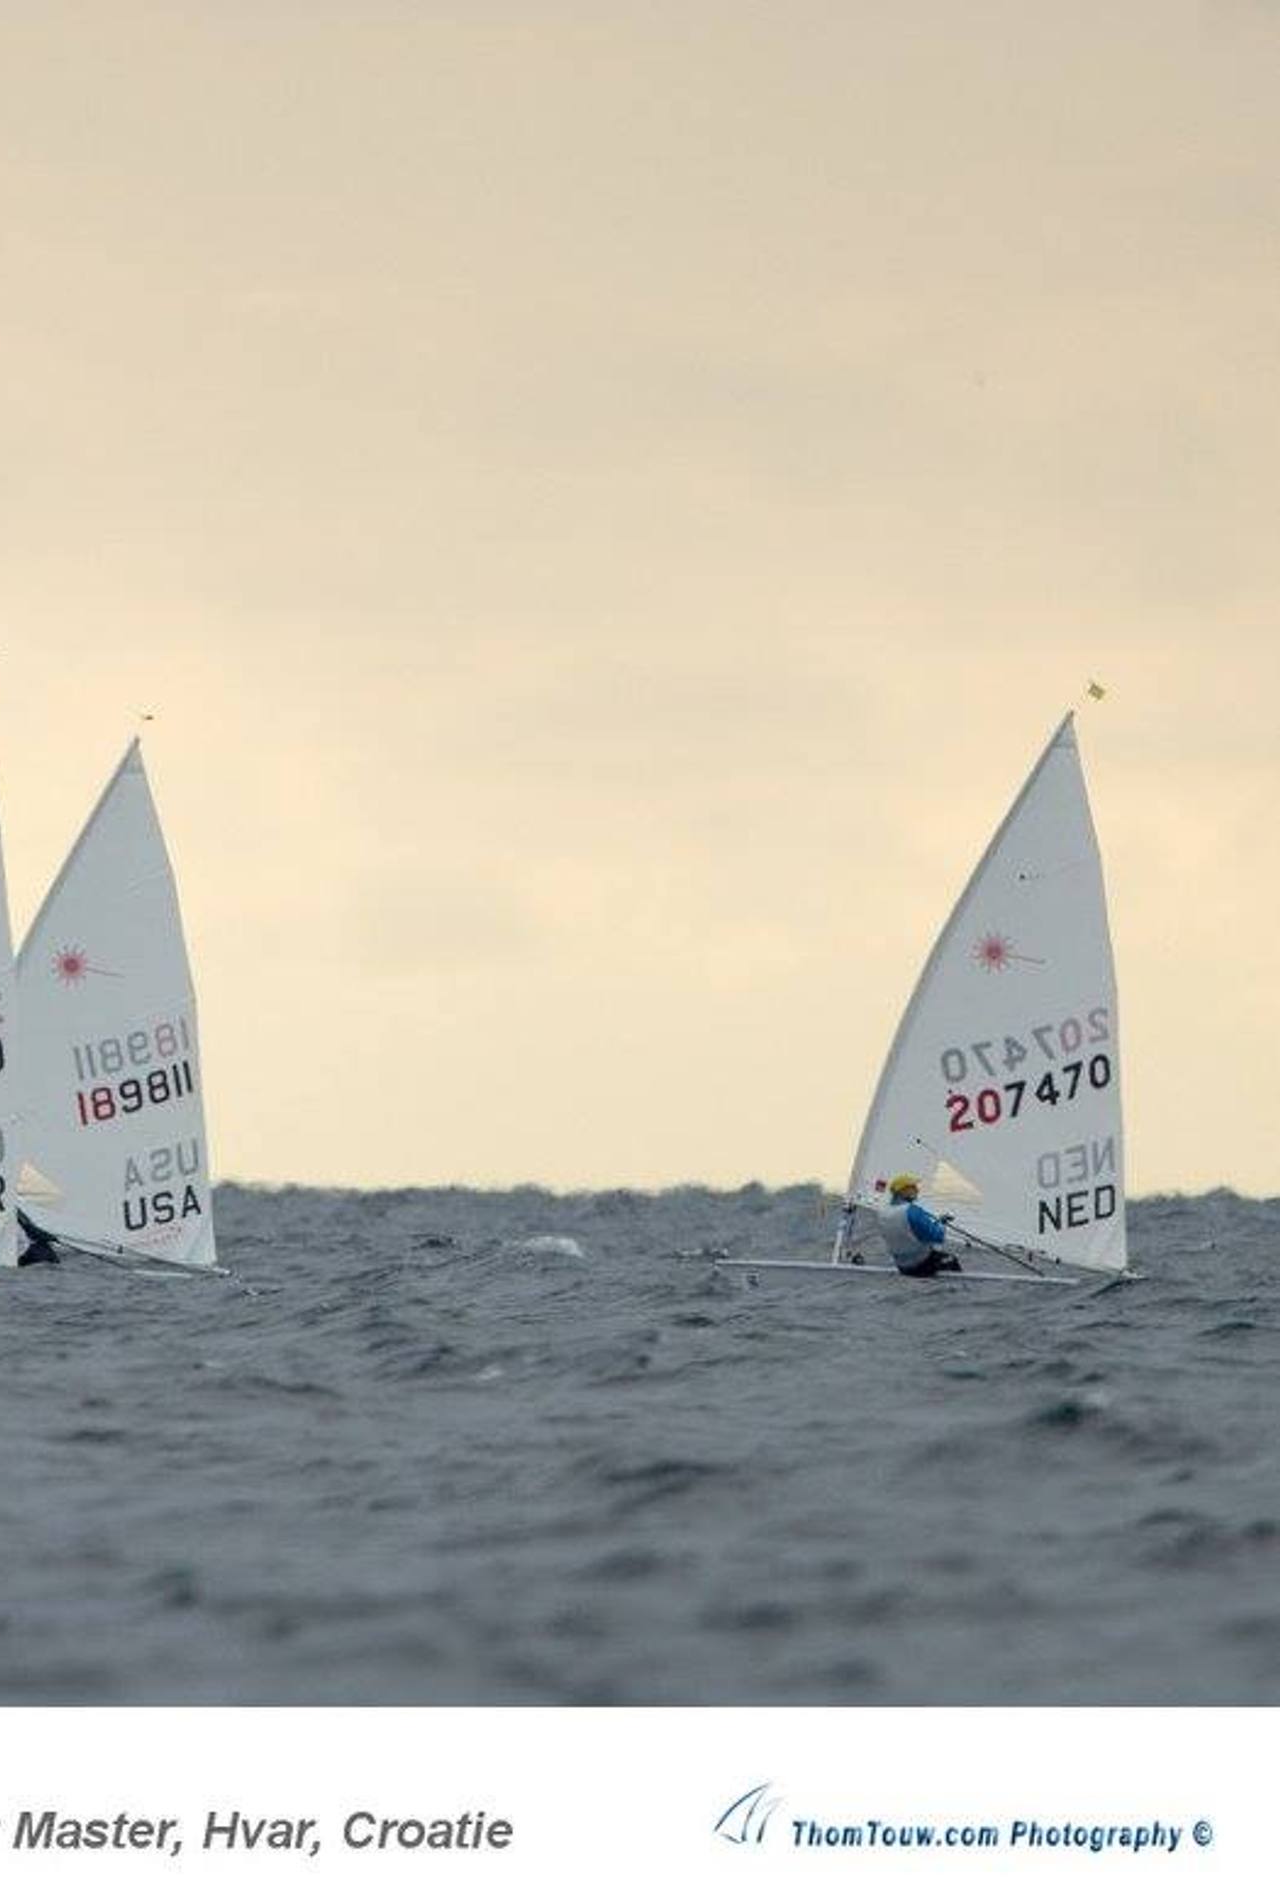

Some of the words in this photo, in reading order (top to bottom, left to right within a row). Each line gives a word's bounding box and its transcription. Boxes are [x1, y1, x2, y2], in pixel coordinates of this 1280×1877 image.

[76, 1060, 194, 1126] 189811
[945, 1054, 1111, 1133] 207470
[123, 1184, 202, 1231] USA
[1038, 1184, 1116, 1234] NED
